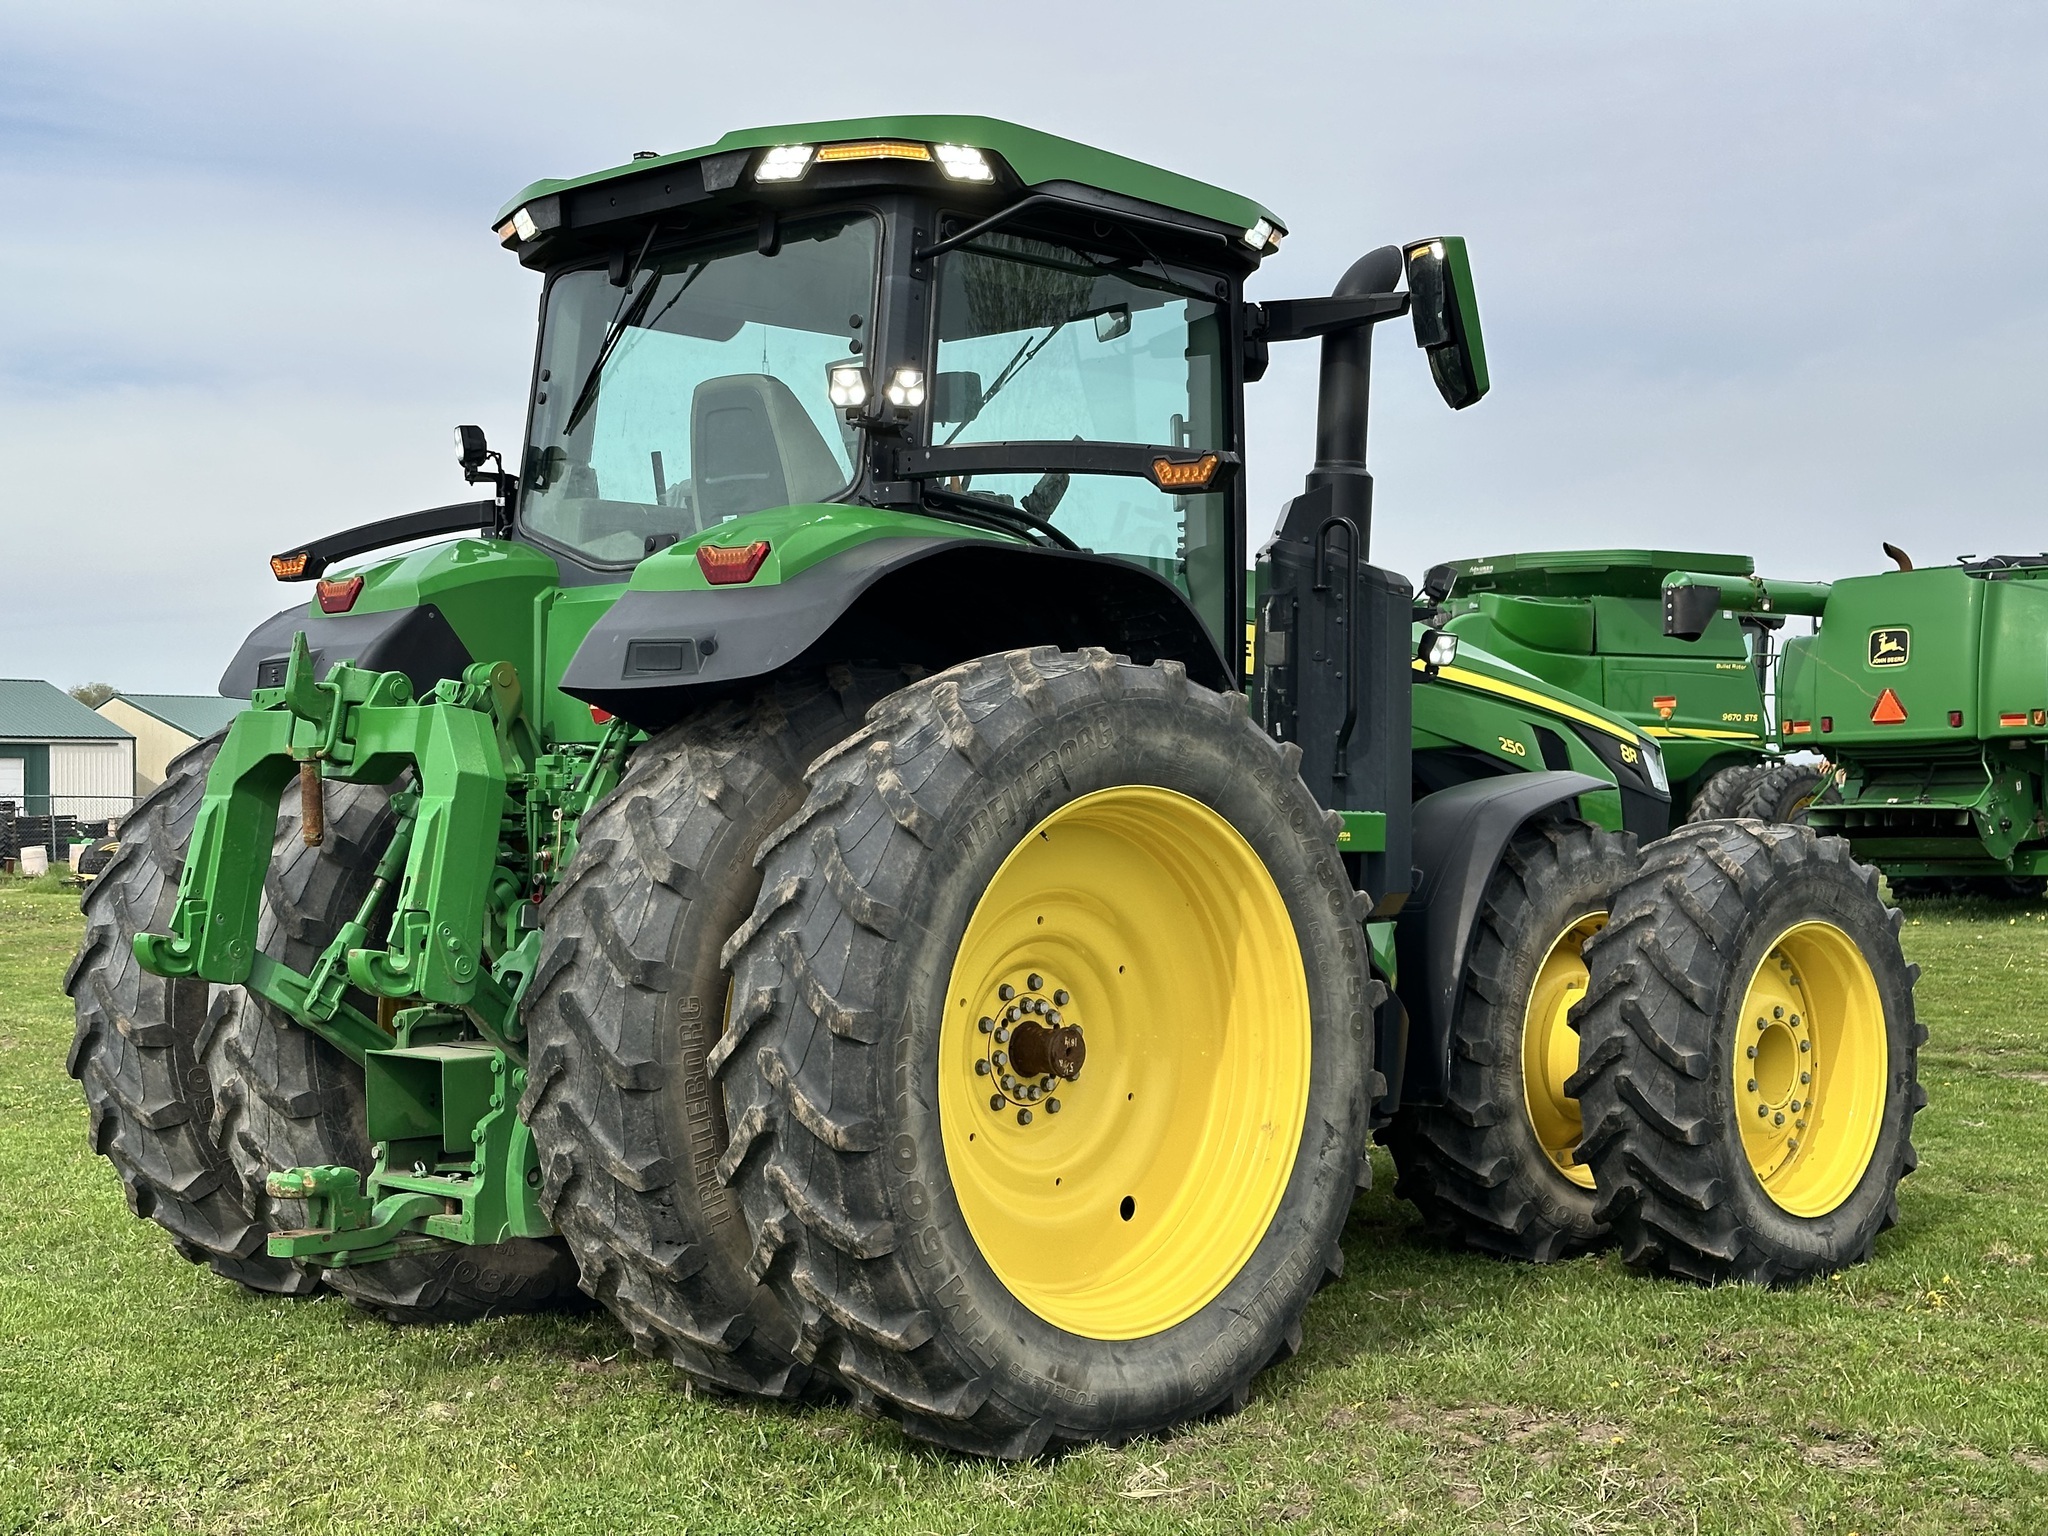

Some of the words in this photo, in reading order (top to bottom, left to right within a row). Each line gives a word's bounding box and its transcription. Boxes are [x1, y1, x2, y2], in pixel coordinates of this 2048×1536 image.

[1498, 736, 1526, 757] 250
[1619, 743, 1639, 765] 8R
[1722, 713, 1742, 722] 9670
[1744, 713, 1759, 722] STS
[953, 715, 1114, 861] TRELLEBORG
[1252, 766, 1344, 917] 480/80
[677, 995, 732, 1236] TRELLEBORG
[1188, 1237, 1319, 1398] TRELLEBORG
[1008, 1361, 1099, 1408] TUBELESS
